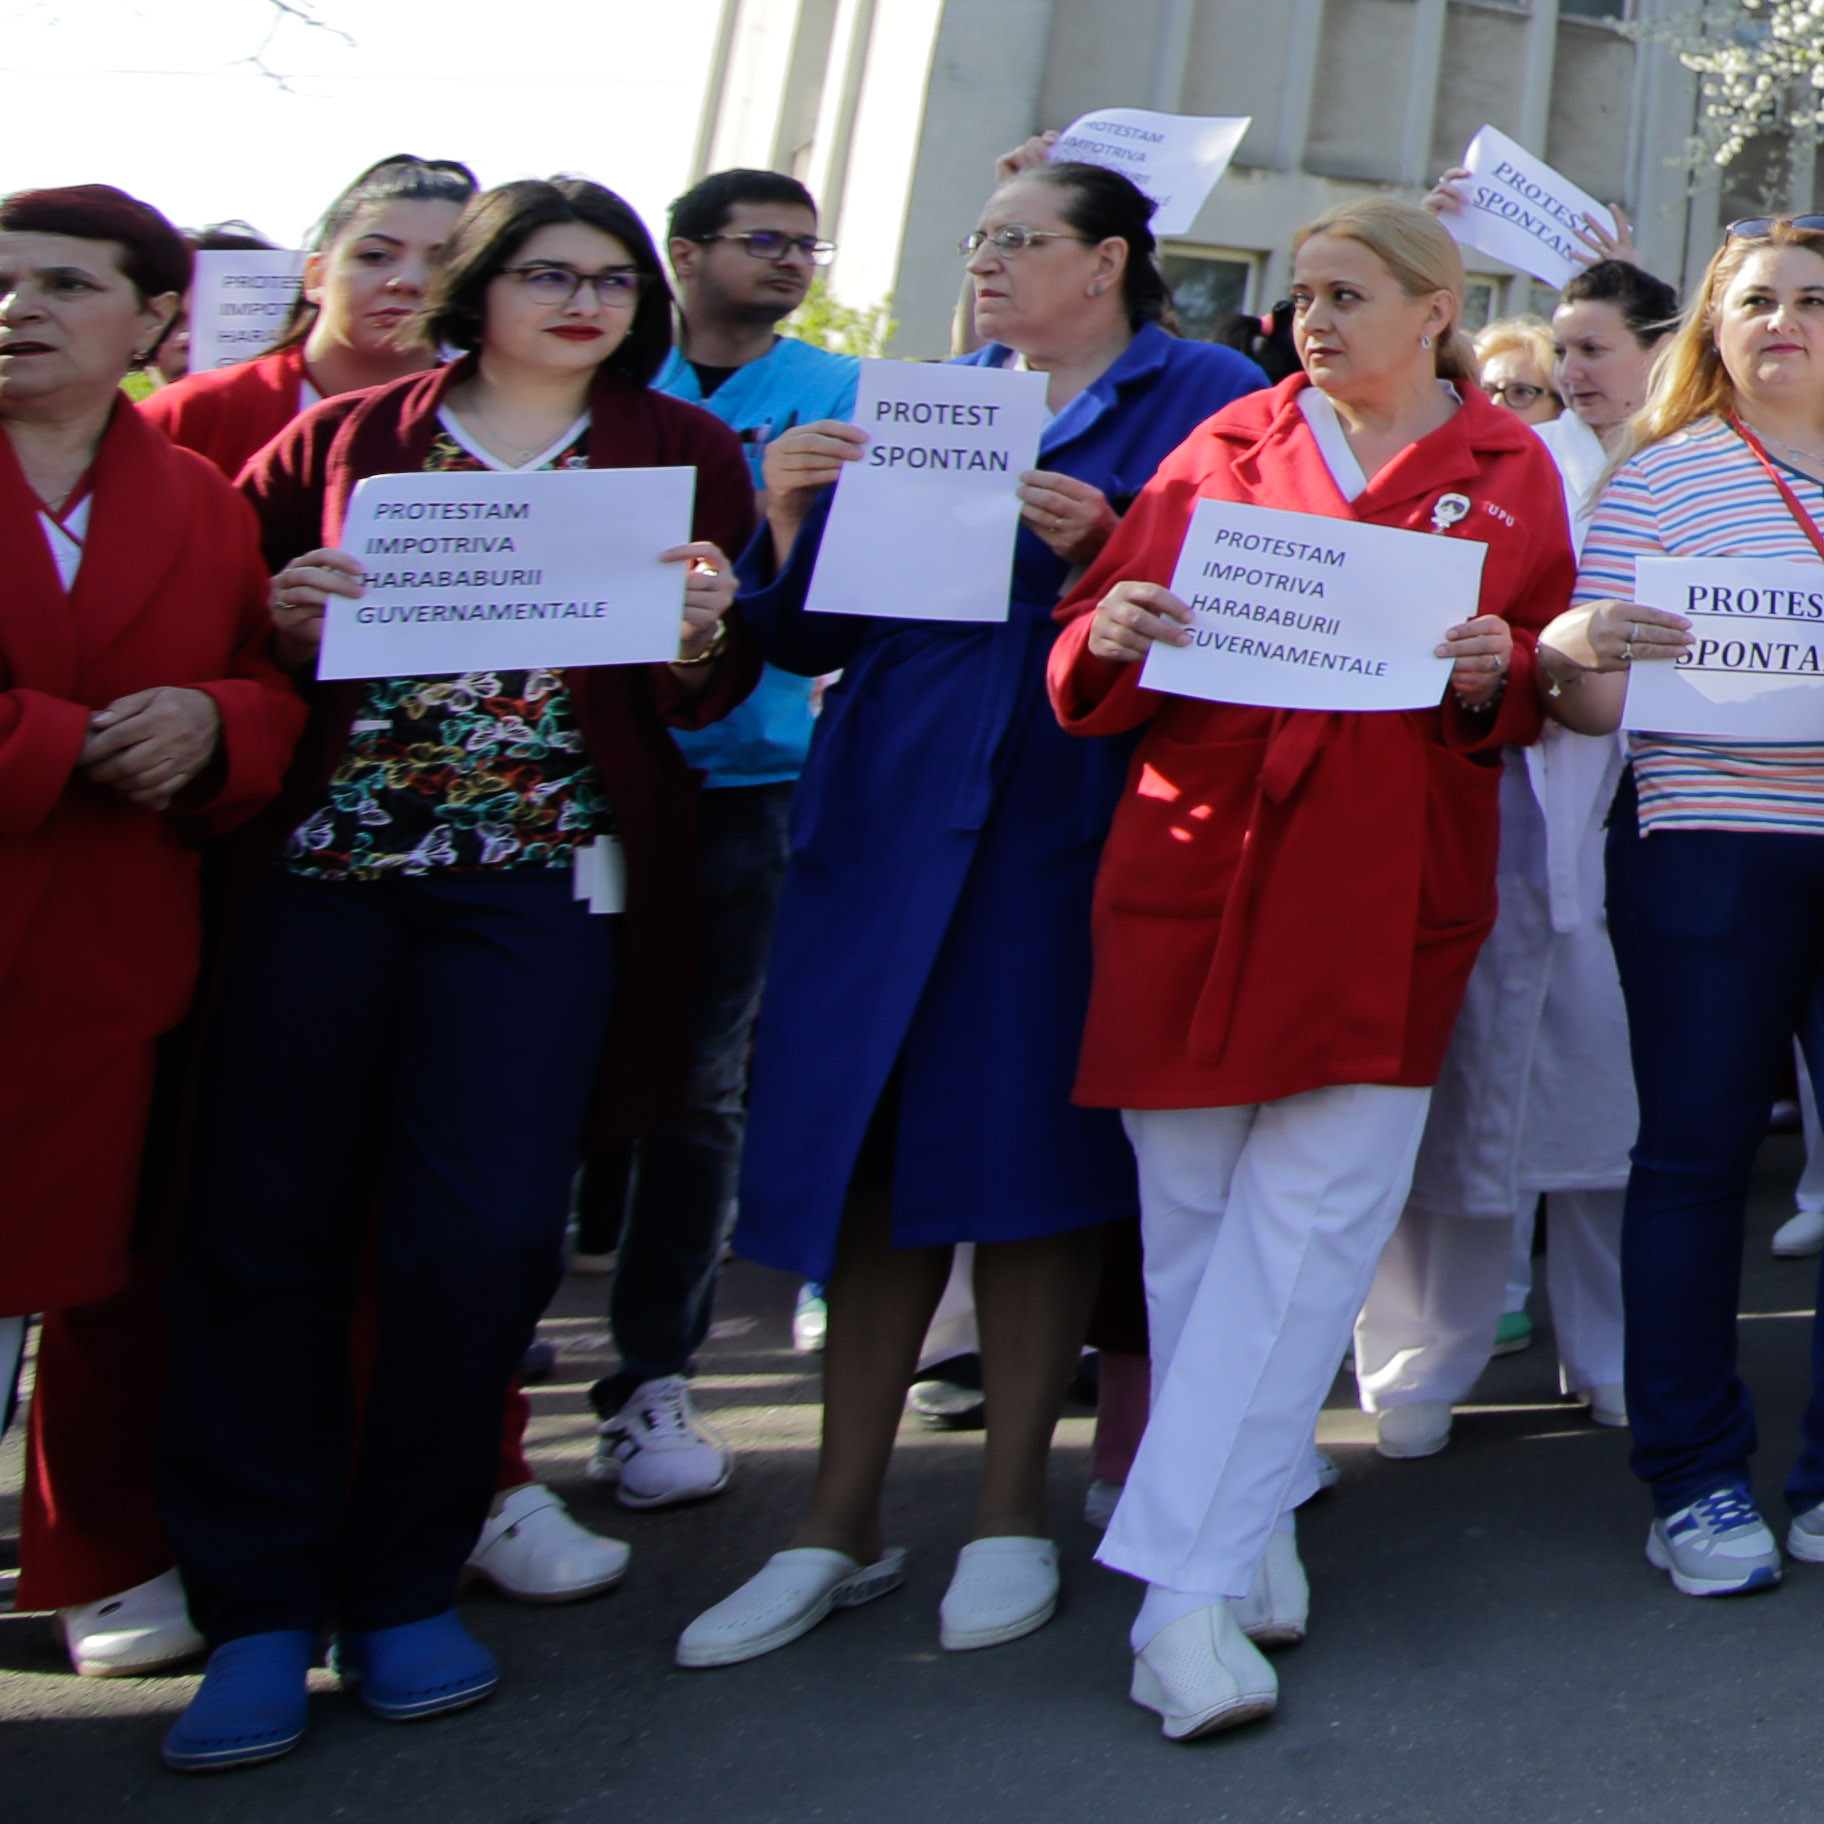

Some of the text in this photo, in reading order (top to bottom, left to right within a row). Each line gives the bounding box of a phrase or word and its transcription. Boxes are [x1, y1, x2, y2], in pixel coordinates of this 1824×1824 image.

[1063, 137, 1147, 162] IMPOTRIVA
[219, 303, 295, 315] IMPOT
[876, 401, 1000, 426] PROTEST
[869, 445, 1009, 472] SPONTAN
[373, 502, 531, 520] PROTESTAM
[365, 536, 516, 555] IMPOTRIVA
[1214, 528, 1346, 567] PROTESTAM
[361, 569, 544, 589] HARABABURII
[1202, 560, 1325, 598] IMPOTRIVA
[355, 601, 608, 624] GUVERNAMENTALE
[1190, 593, 1341, 636] HARABABURII
